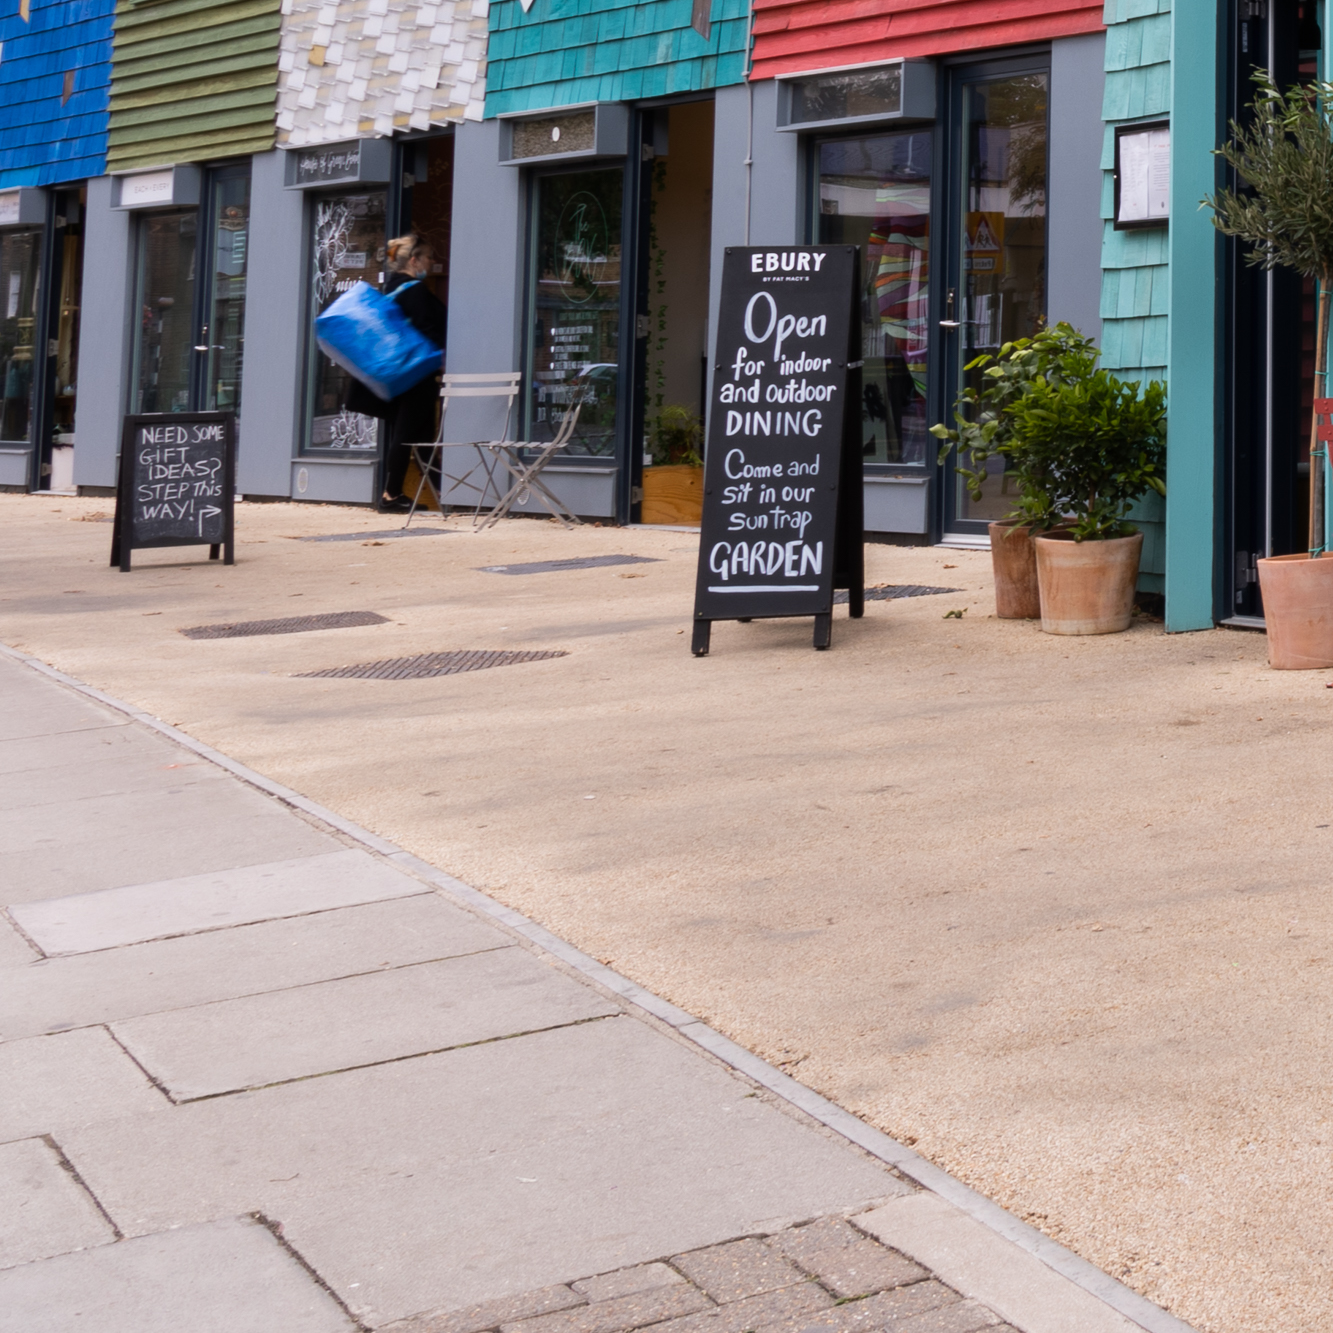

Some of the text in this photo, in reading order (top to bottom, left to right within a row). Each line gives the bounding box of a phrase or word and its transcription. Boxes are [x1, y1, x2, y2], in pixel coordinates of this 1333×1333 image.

[751, 252, 826, 272] EBURY
[744, 291, 826, 362] Open
[732, 346, 832, 381] for indoor
[720, 378, 837, 404] and outdoor
[142, 425, 224, 444] NEED SOME
[726, 409, 822, 436] DINING
[724, 448, 820, 480] Come and
[138, 482, 190, 502] STEP
[721, 482, 815, 504] sit in our
[143, 499, 194, 521] WAY!
[710, 540, 823, 580] GARDEN
